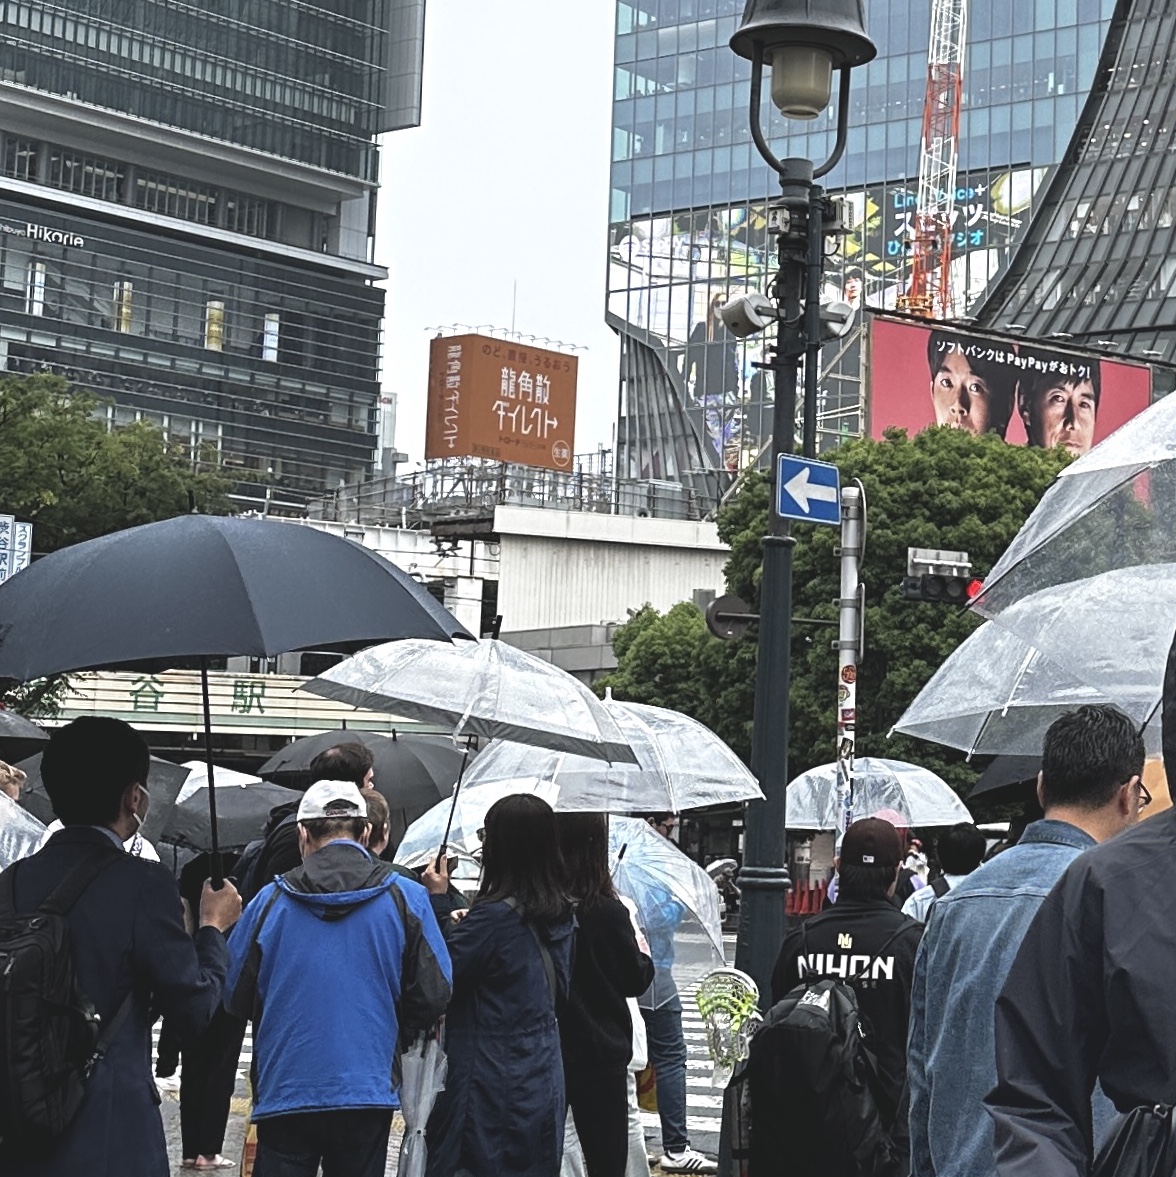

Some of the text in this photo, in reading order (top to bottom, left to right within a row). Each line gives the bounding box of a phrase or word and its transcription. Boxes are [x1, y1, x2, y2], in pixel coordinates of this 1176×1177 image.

[27, 223, 84, 248] Hikarie
[500, 366, 551, 405] 龍角散
